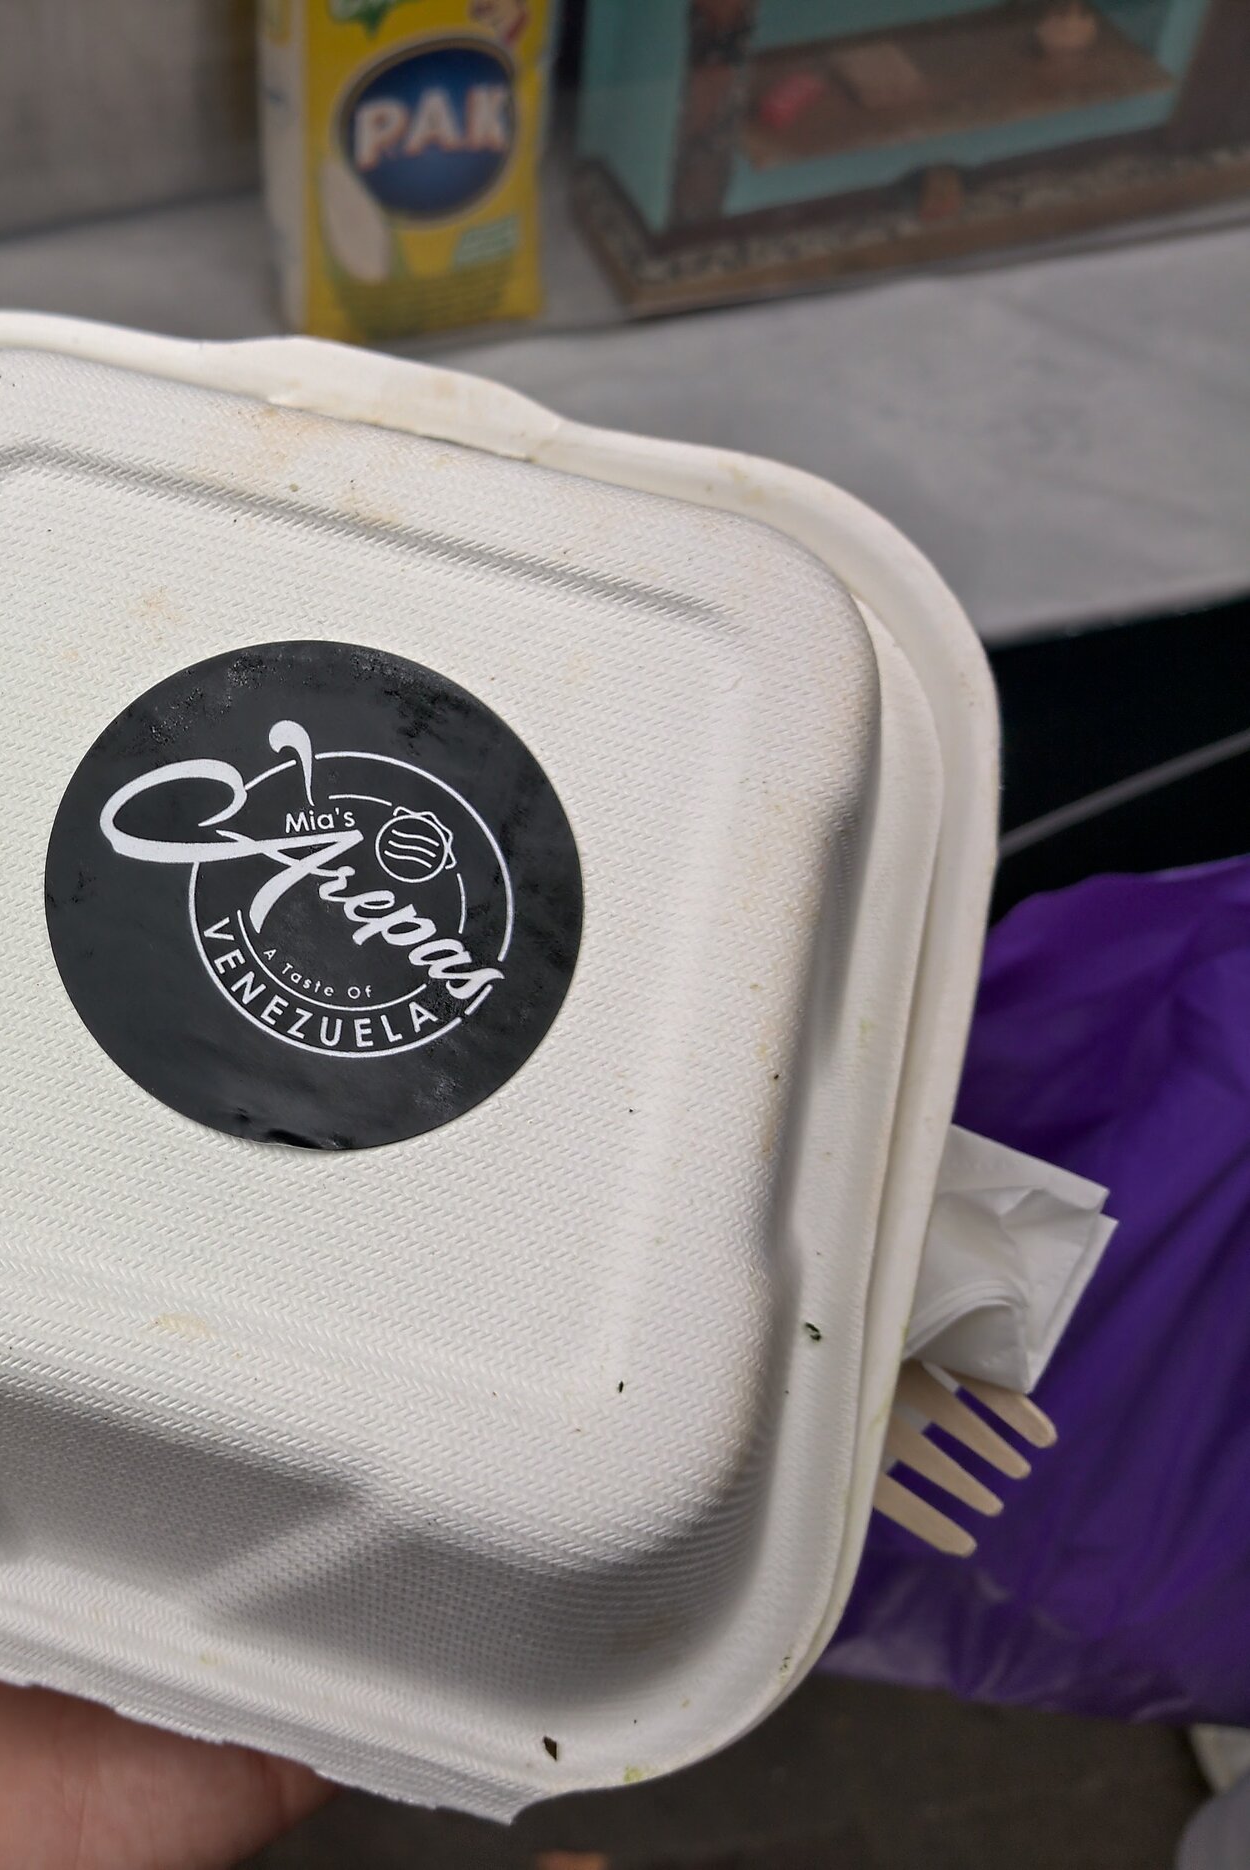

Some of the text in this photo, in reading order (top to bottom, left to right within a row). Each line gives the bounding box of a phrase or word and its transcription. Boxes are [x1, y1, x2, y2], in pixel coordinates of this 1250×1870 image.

[284, 807, 356, 834] Mia's
[202, 916, 440, 1048] VENEZUELA
[262, 947, 373, 1000] A Taste Of
